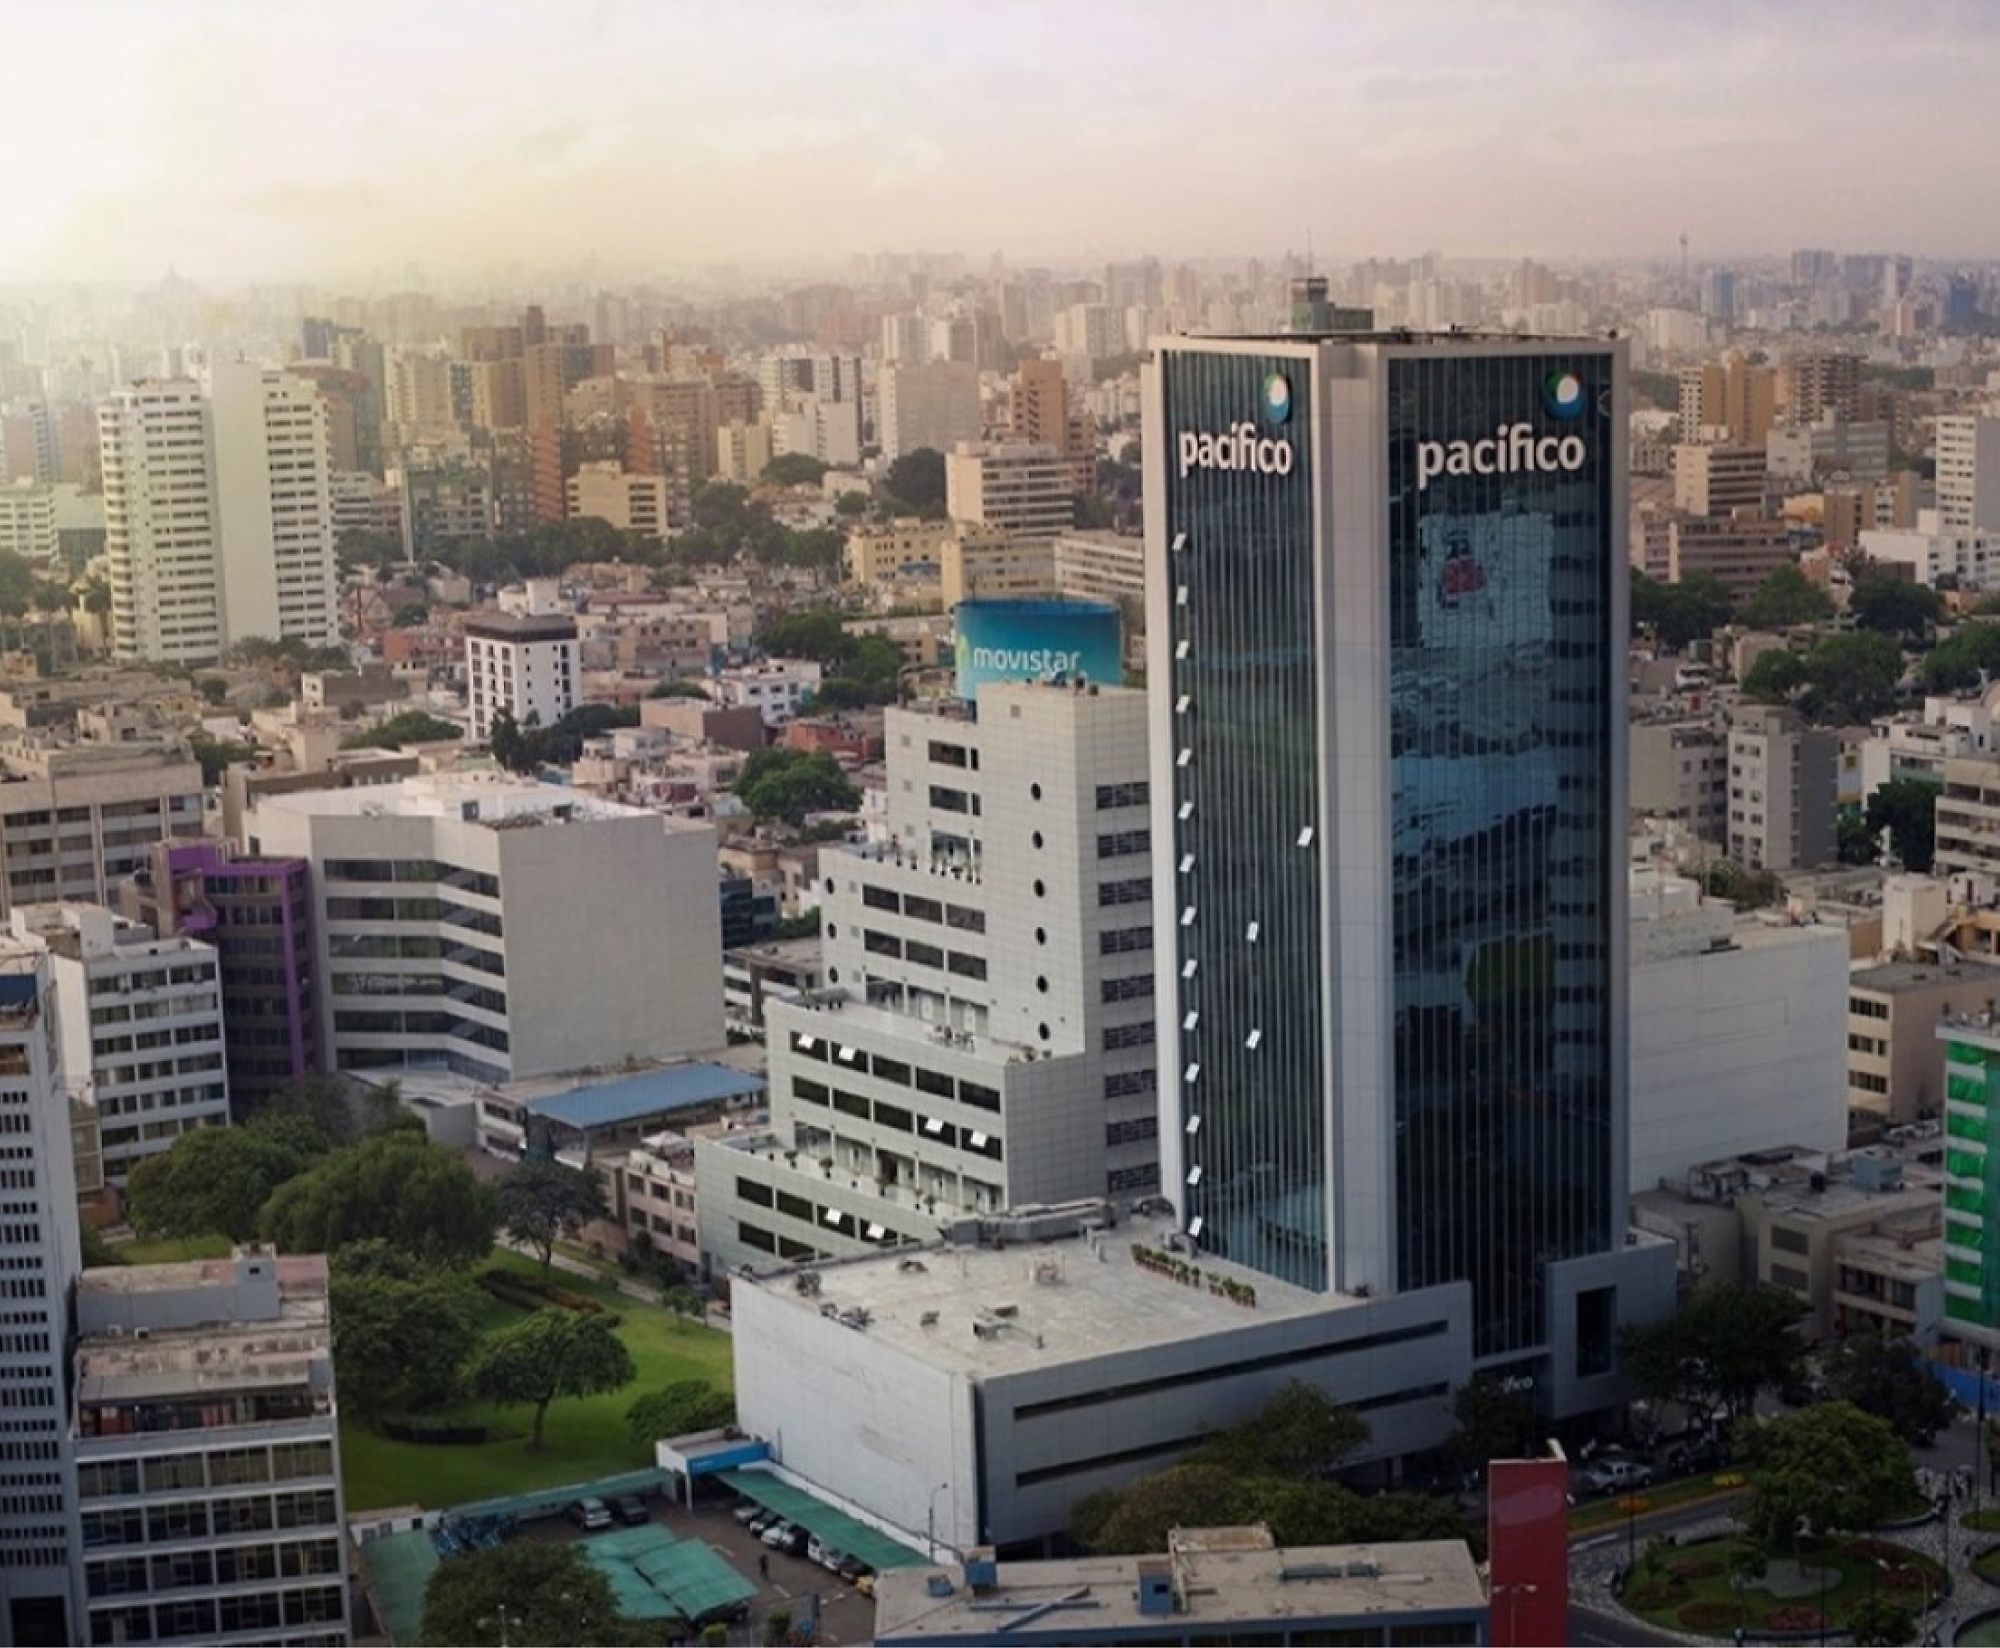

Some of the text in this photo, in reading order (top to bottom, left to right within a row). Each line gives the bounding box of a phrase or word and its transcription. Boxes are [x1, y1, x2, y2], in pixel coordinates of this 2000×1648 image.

[1179, 421, 1291, 478] pacifico
[1418, 422, 1585, 490] pacifico
[974, 647, 1081, 671] movistar
